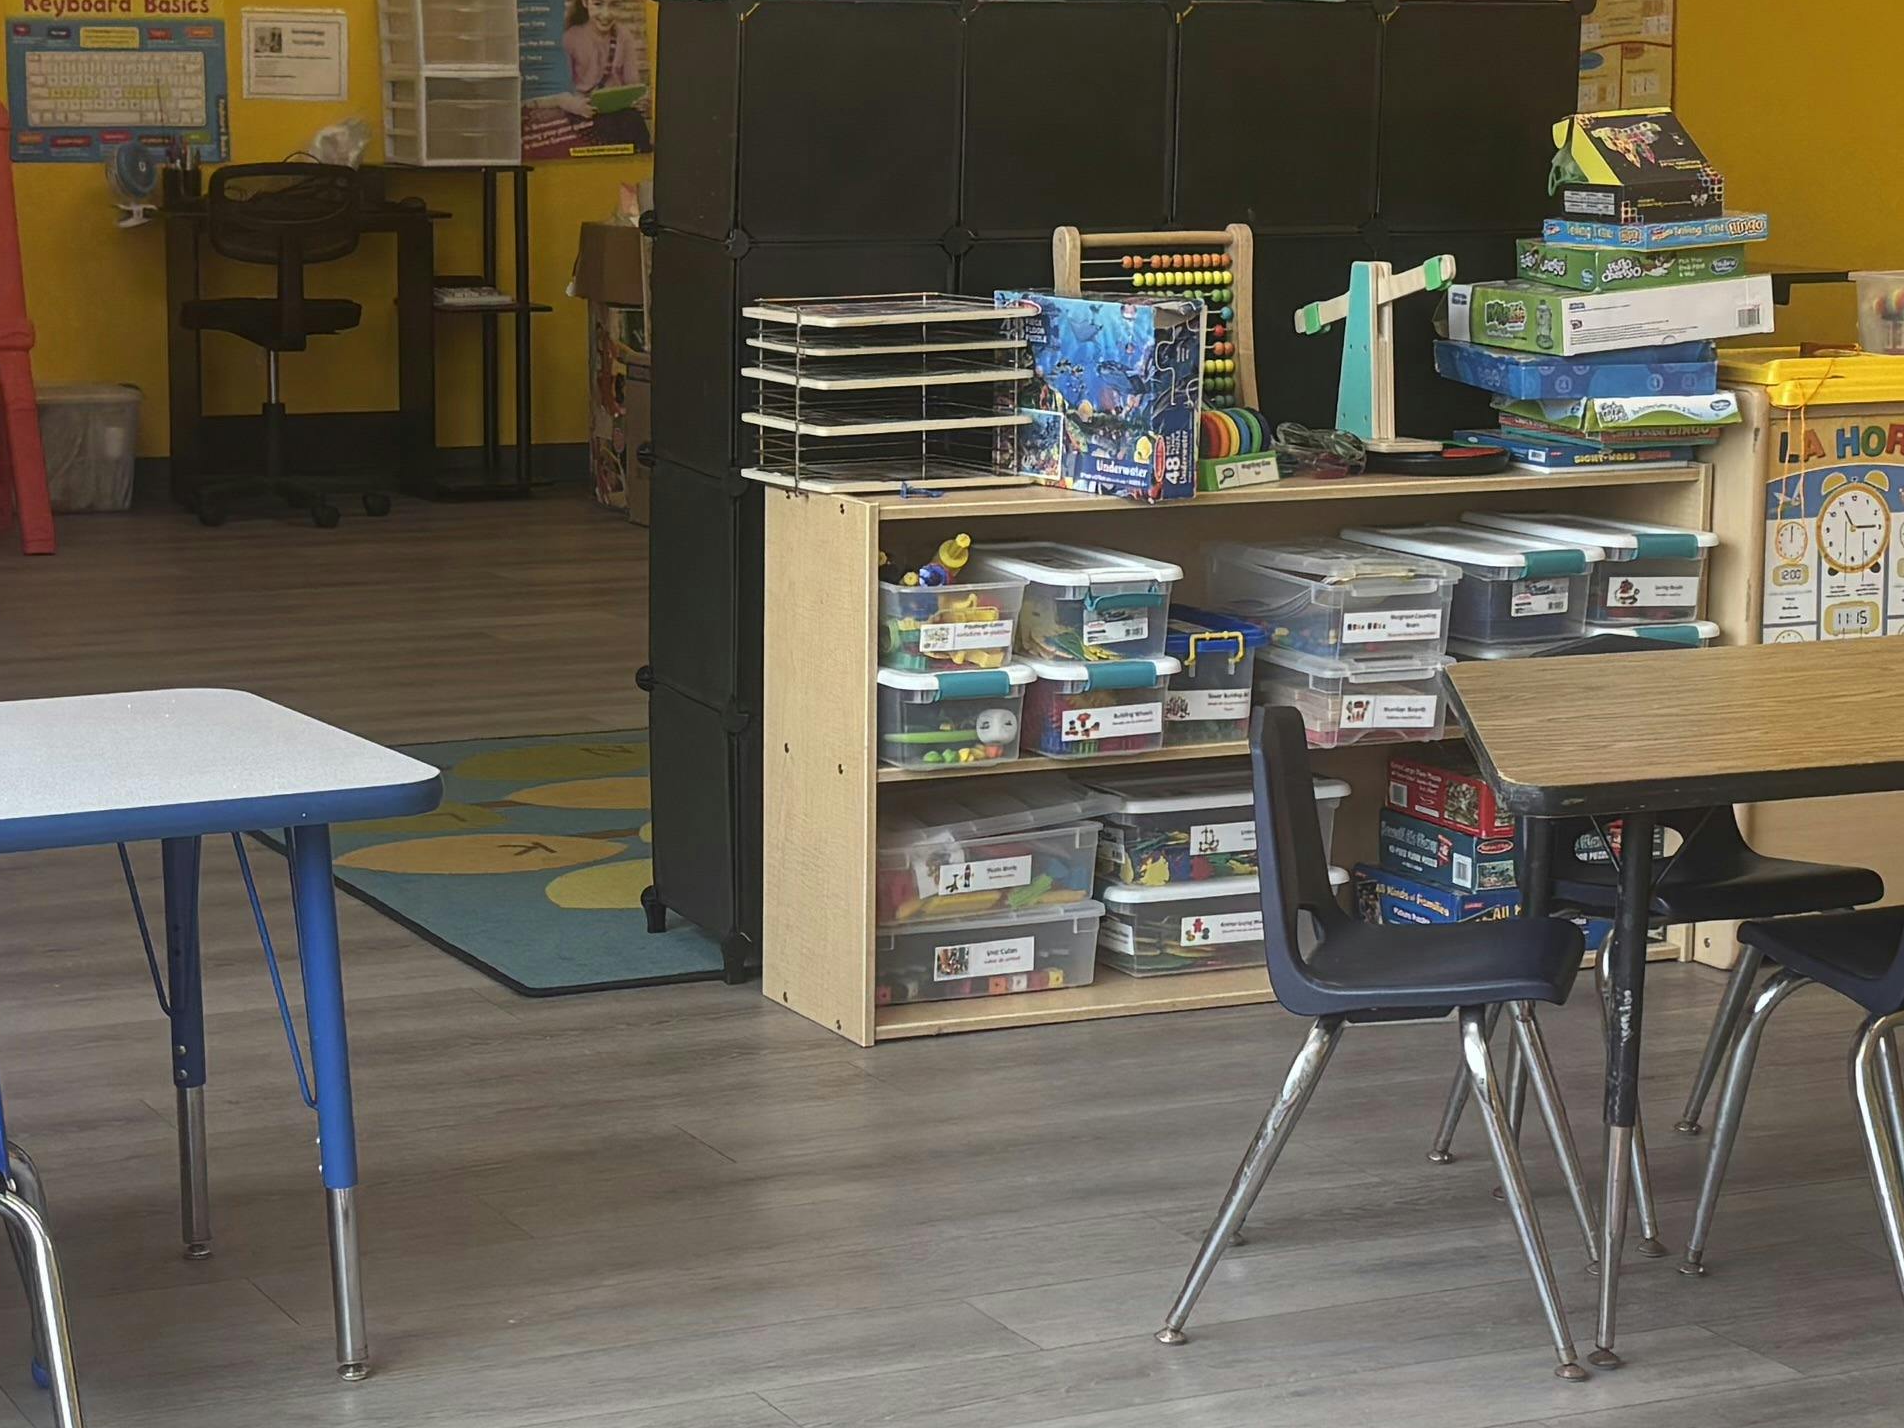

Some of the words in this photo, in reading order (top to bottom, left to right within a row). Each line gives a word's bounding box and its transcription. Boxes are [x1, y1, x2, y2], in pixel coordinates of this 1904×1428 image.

[1025, 326, 1045, 335] FLOOR
[1025, 334, 1047, 343] PUZZLE
[1779, 428, 1826, 463] LA
[1096, 459, 1148, 478] Underwater
[1166, 456, 1180, 484] 48
[1837, 609, 1868, 626] 11:15
[1493, 905, 1510, 921] All
